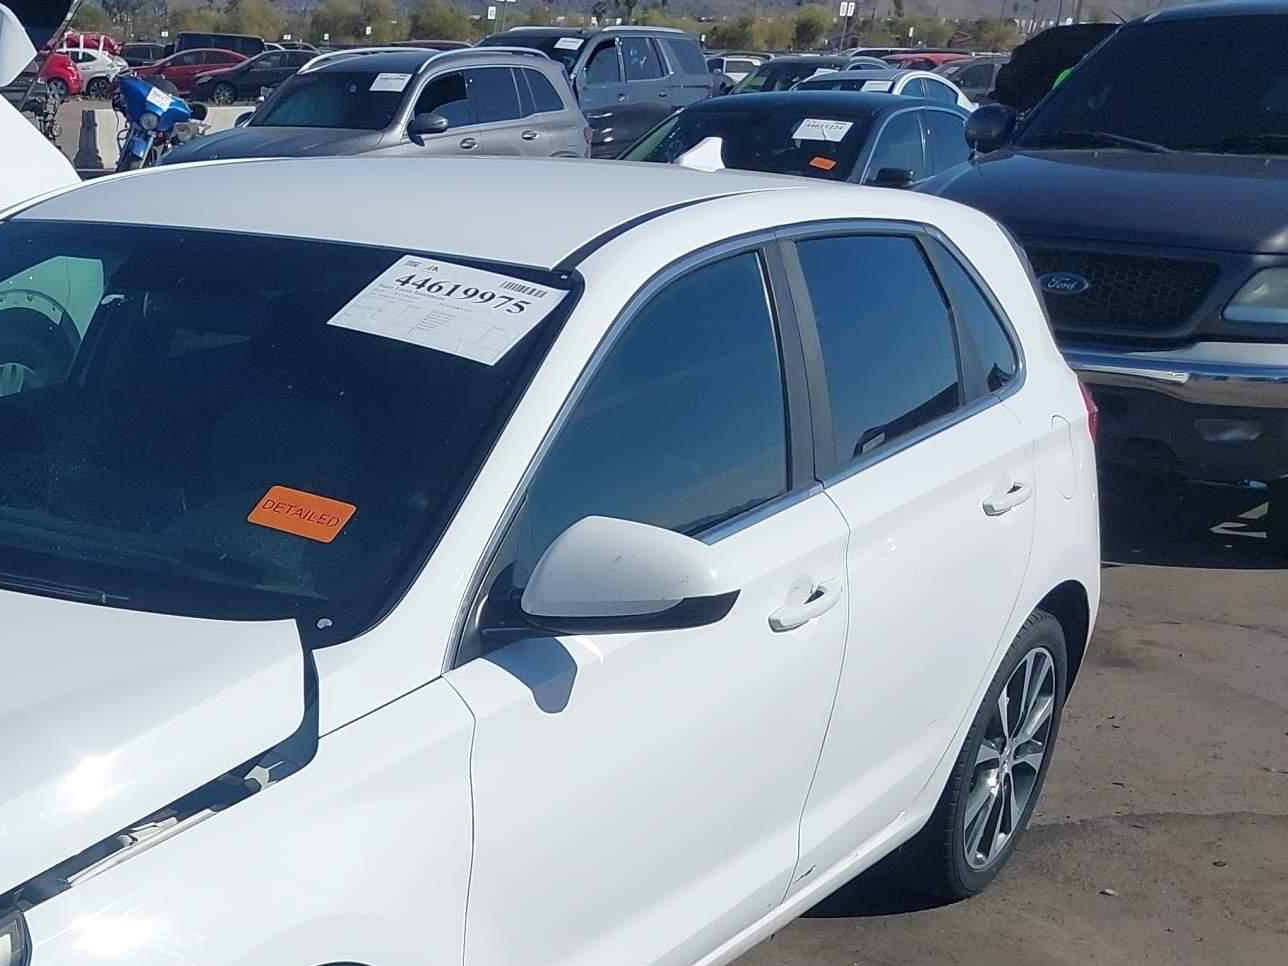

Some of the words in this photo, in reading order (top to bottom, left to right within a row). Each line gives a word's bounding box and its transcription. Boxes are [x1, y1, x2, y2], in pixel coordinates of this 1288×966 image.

[394, 273, 534, 315] 44619975
[1047, 276, 1078, 290] Ford
[261, 498, 341, 528] DETAILED
